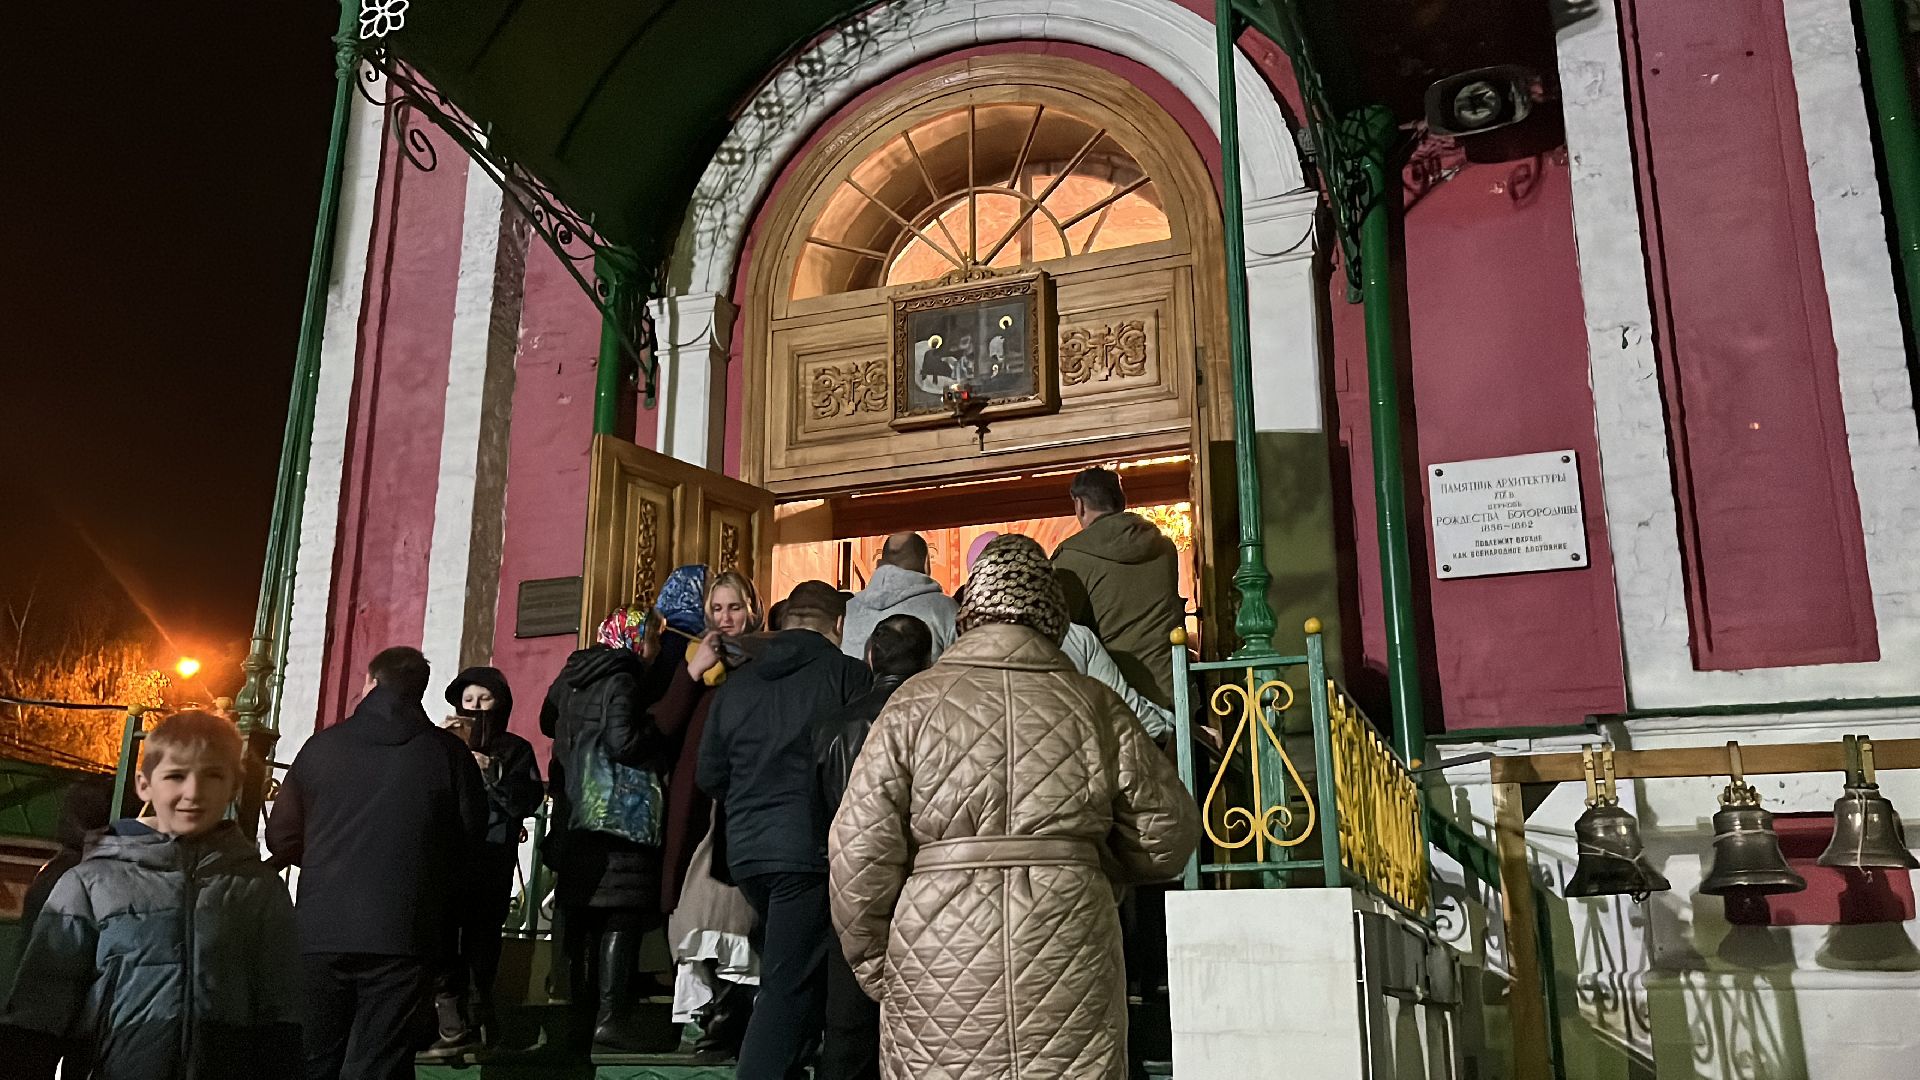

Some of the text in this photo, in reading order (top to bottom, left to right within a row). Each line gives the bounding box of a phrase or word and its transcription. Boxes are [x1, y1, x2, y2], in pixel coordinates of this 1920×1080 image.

[1441, 473, 1567, 494] ПАМЯТНИК АРХИТЕКТУРЫ
[1436, 505, 1578, 526] РОЖДЕСТВА БОГОРОДИЦЫ
[1470, 547, 1521, 558] ВСЕНАРОДНОЕ
[1525, 542, 1568, 553] ДОСТОЯНИЕ
[1475, 535, 1543, 547] ПОДЛЕЖИТ ОХРАНЕ
